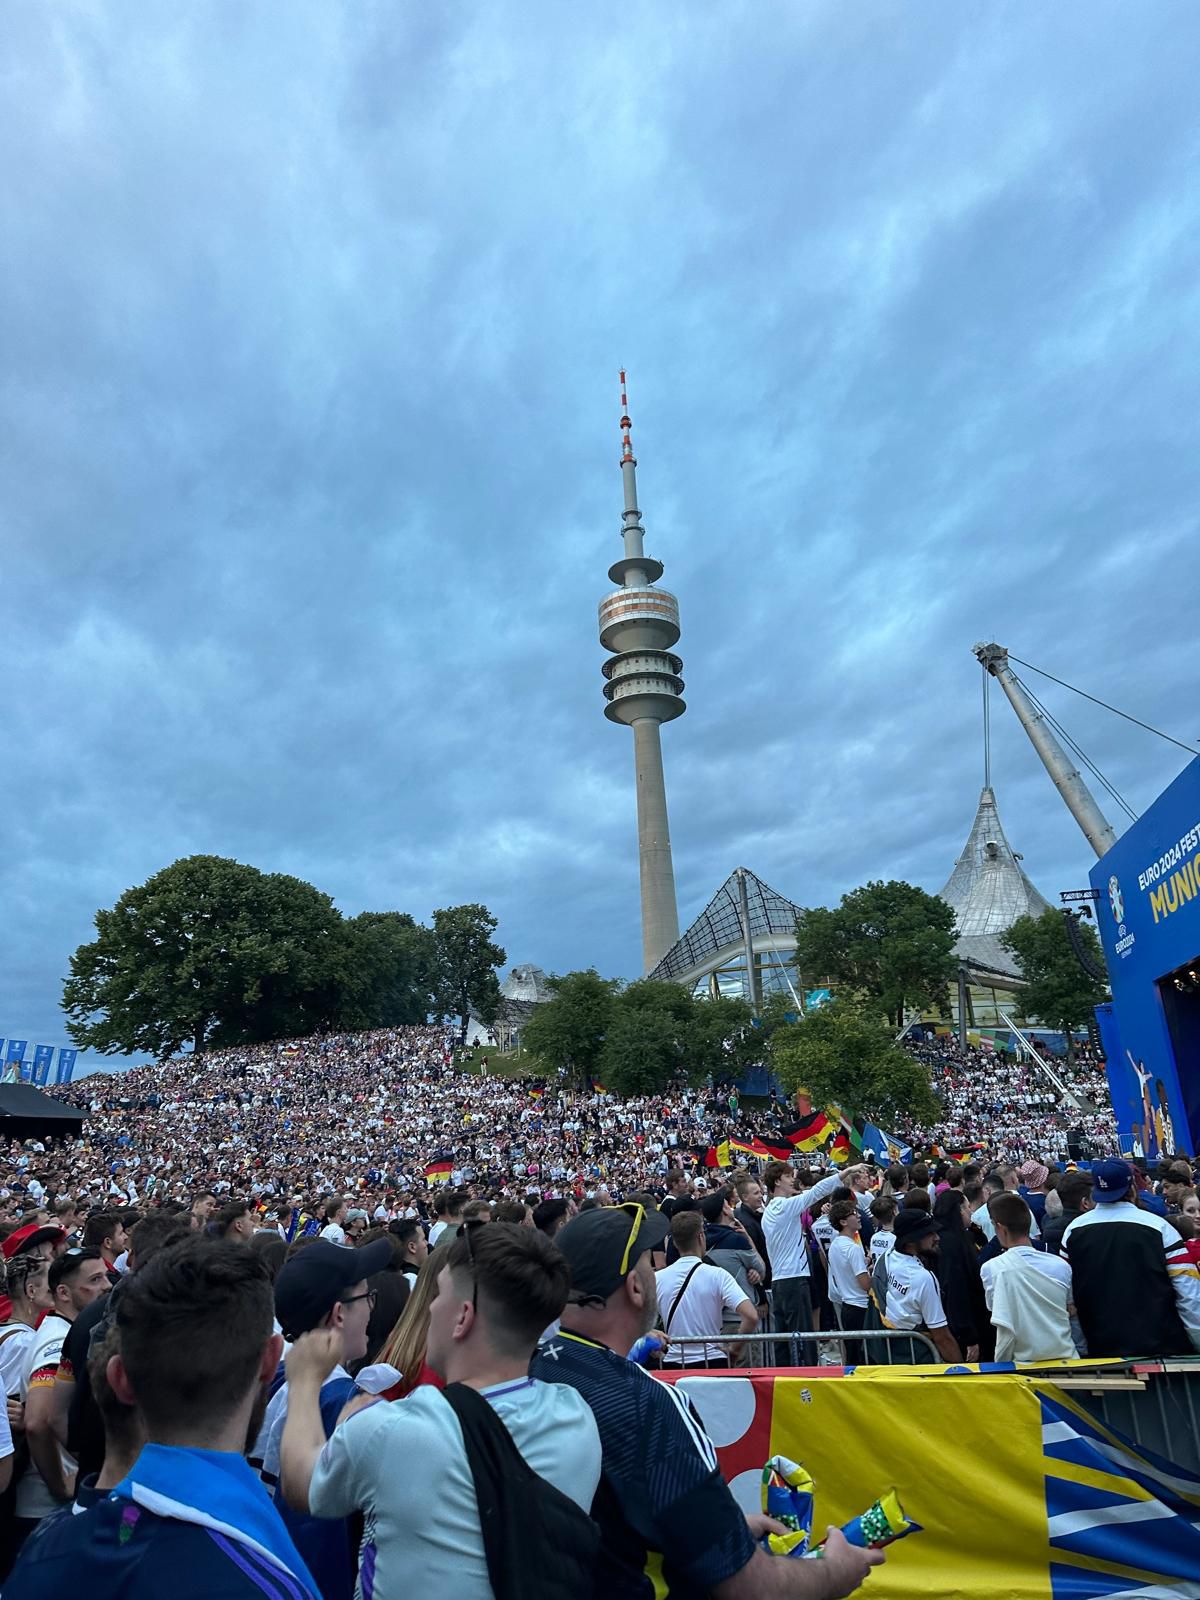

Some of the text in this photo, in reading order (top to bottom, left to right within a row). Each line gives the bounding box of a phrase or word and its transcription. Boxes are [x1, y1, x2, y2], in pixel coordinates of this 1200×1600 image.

[1138, 822, 1200, 891] EURO 2024 FEST
